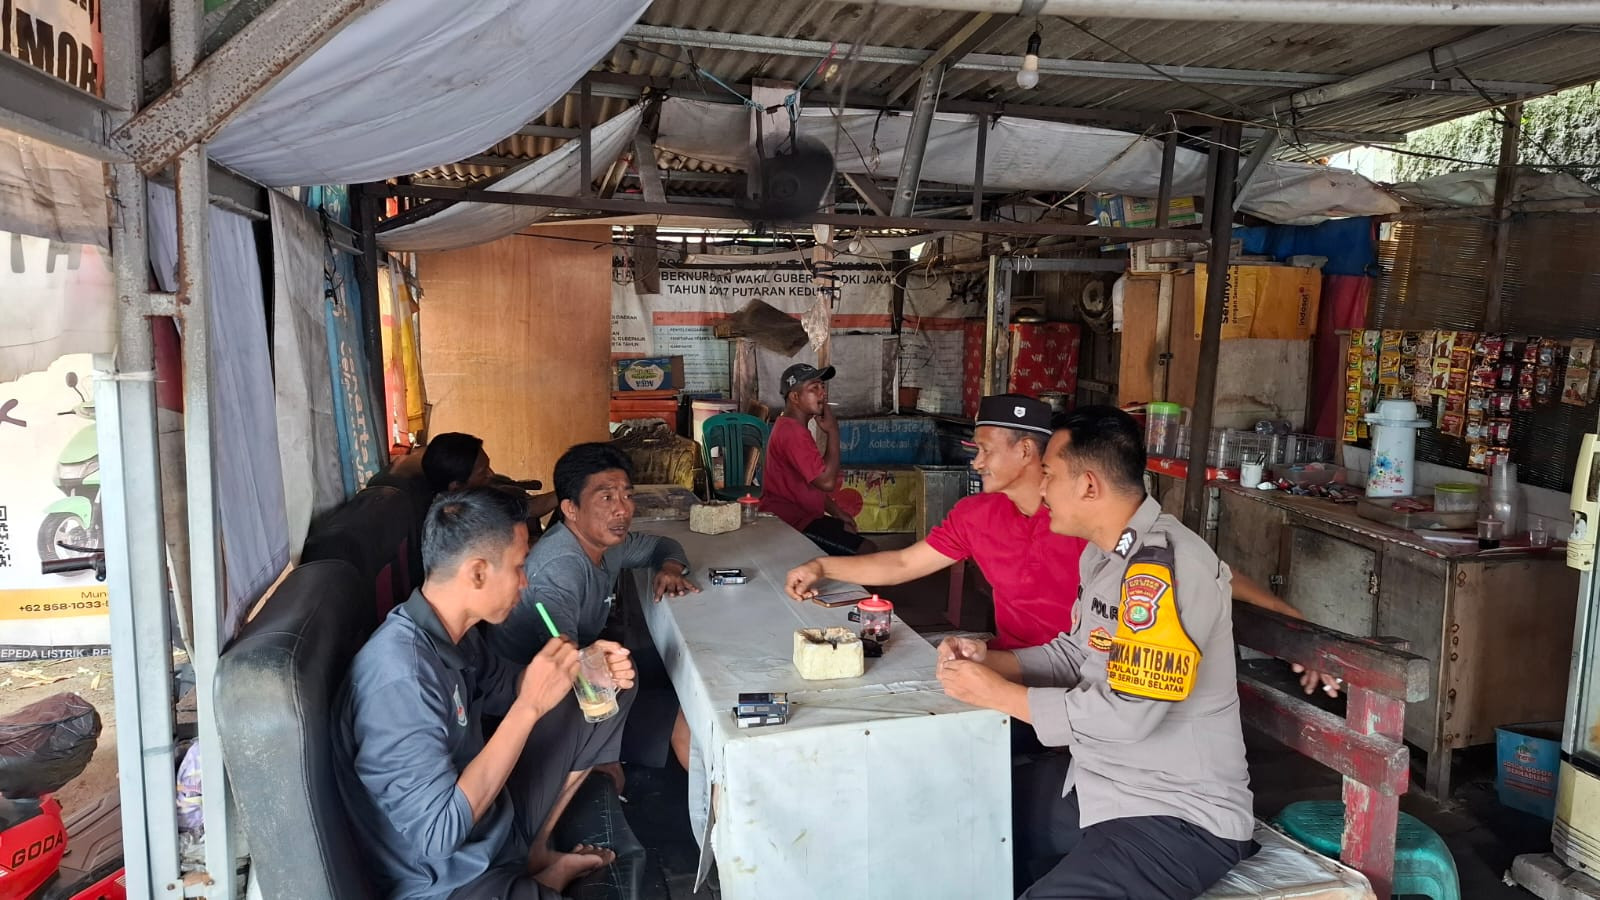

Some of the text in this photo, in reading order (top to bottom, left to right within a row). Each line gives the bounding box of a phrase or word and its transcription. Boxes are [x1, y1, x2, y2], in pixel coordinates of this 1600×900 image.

[735, 274, 770, 284] WAKIL
[773, 273, 813, 284] GUBER
[667, 284, 706, 295] TAHUN
[709, 285, 729, 297] 2017
[732, 287, 785, 297] PUTARAN
[19, 604, 41, 612] +62
[1, 648, 38, 658] EPEDA
[41, 649, 84, 658] LISTRIK
[1112, 663, 1139, 676] PULAU
[1143, 670, 1184, 684] TIDUNG
[1118, 673, 1146, 686] SERIBU
[1147, 680, 1184, 693] SELATAN
[11, 829, 64, 869] GODA
